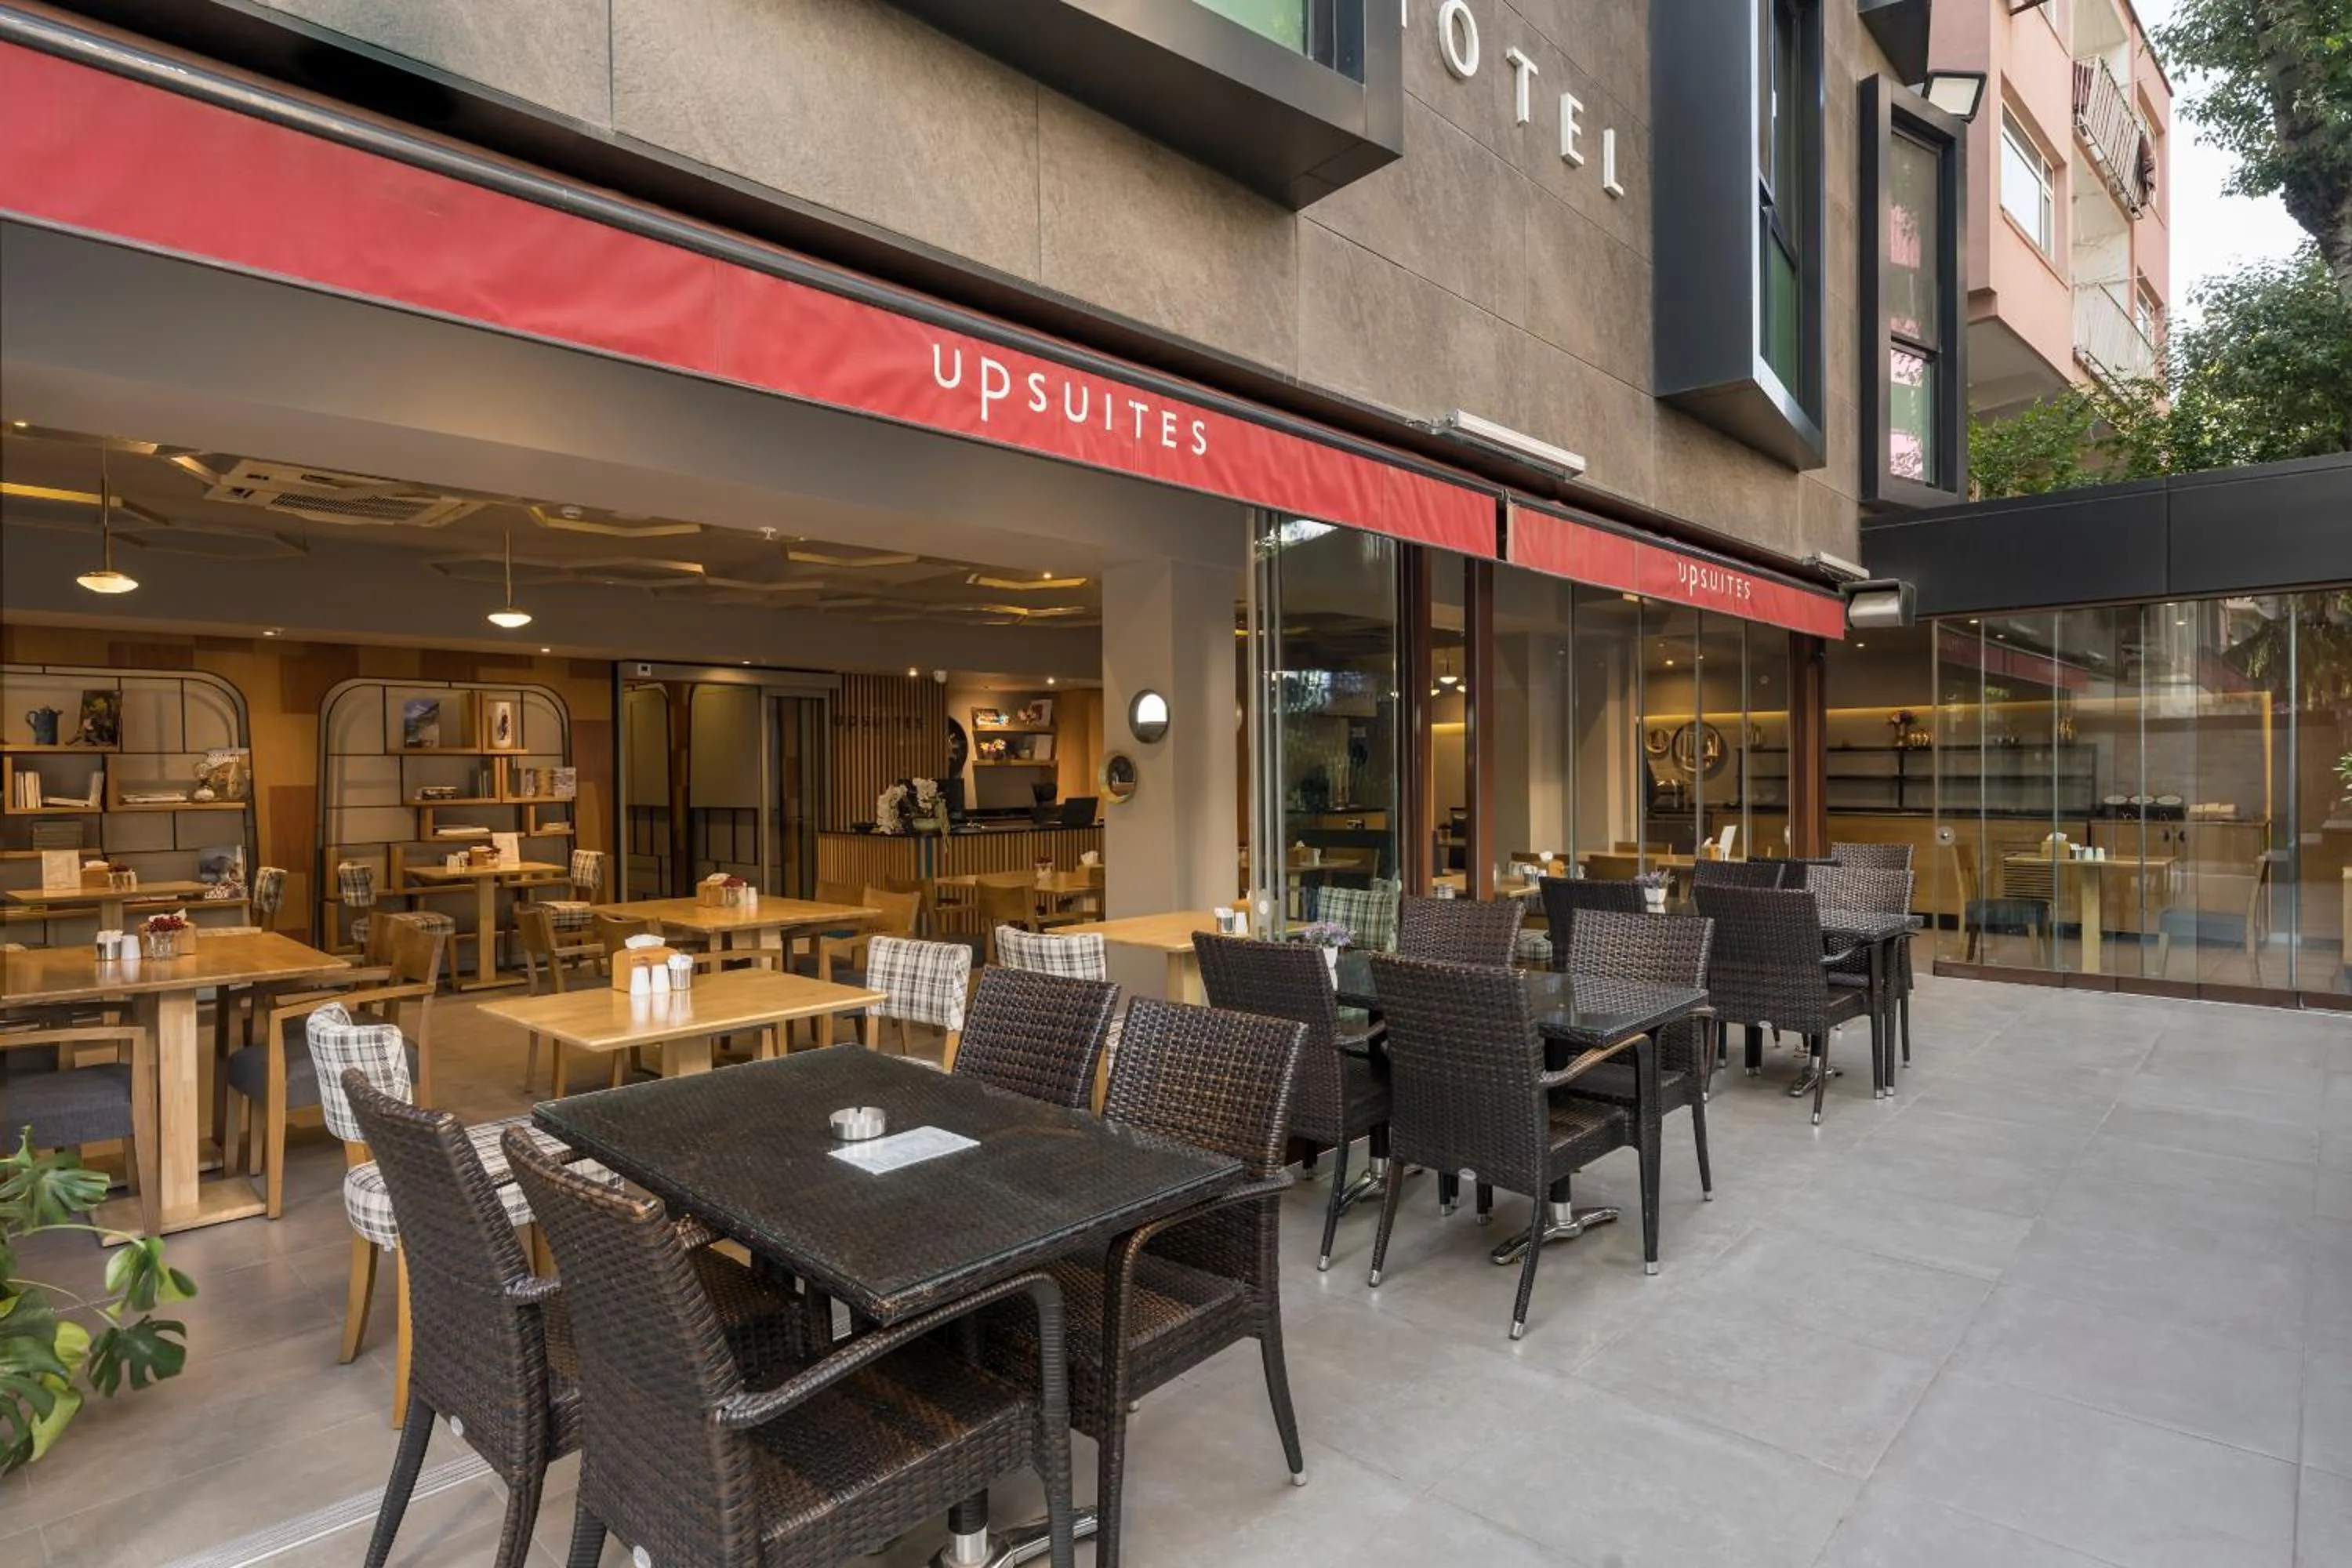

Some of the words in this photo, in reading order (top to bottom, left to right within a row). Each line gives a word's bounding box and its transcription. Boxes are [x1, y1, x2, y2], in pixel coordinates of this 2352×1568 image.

[1400, 0, 1625, 198] OTEL
[932, 343, 1207, 456] UPSUITES
[1678, 561, 1751, 601] UPSUITES
